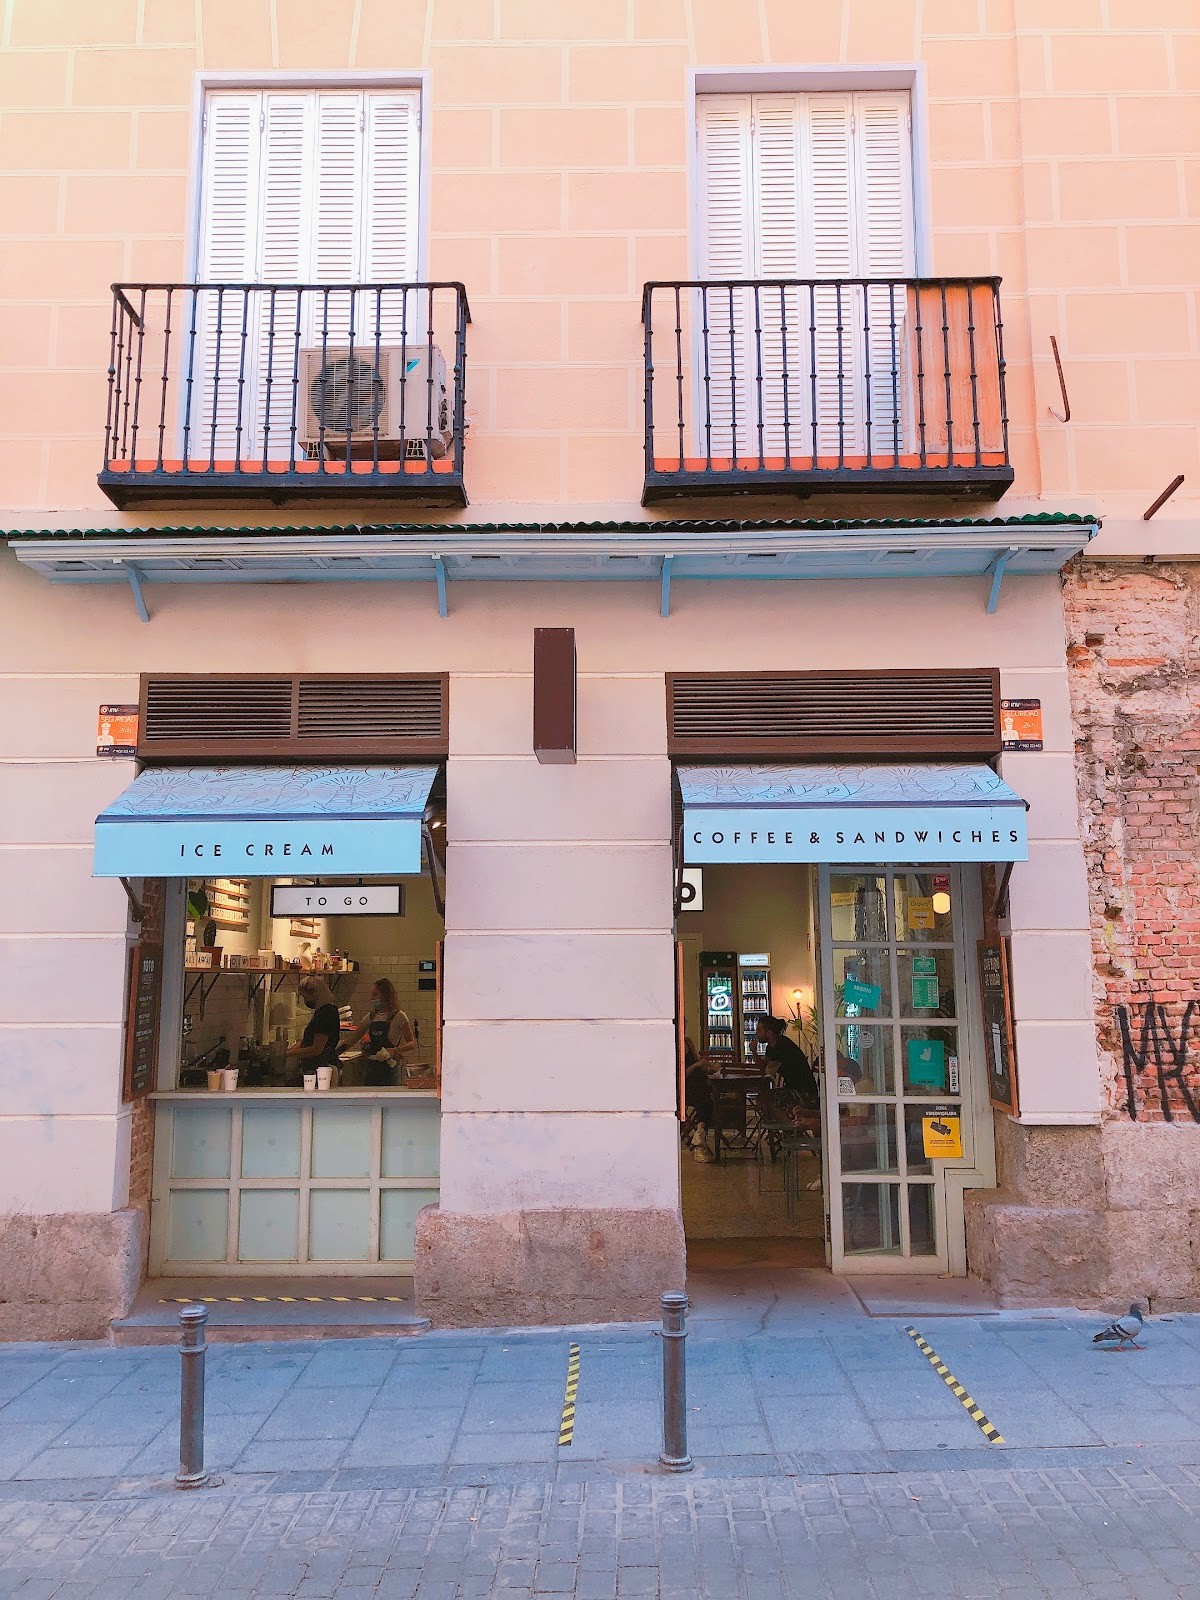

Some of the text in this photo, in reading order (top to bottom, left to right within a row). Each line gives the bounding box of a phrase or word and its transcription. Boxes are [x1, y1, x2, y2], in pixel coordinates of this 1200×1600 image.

[693, 830, 1019, 845] COFFEE & SANDWICHES
[180, 843, 335, 857] ICE CREAM
[305, 896, 369, 906] TO GO
